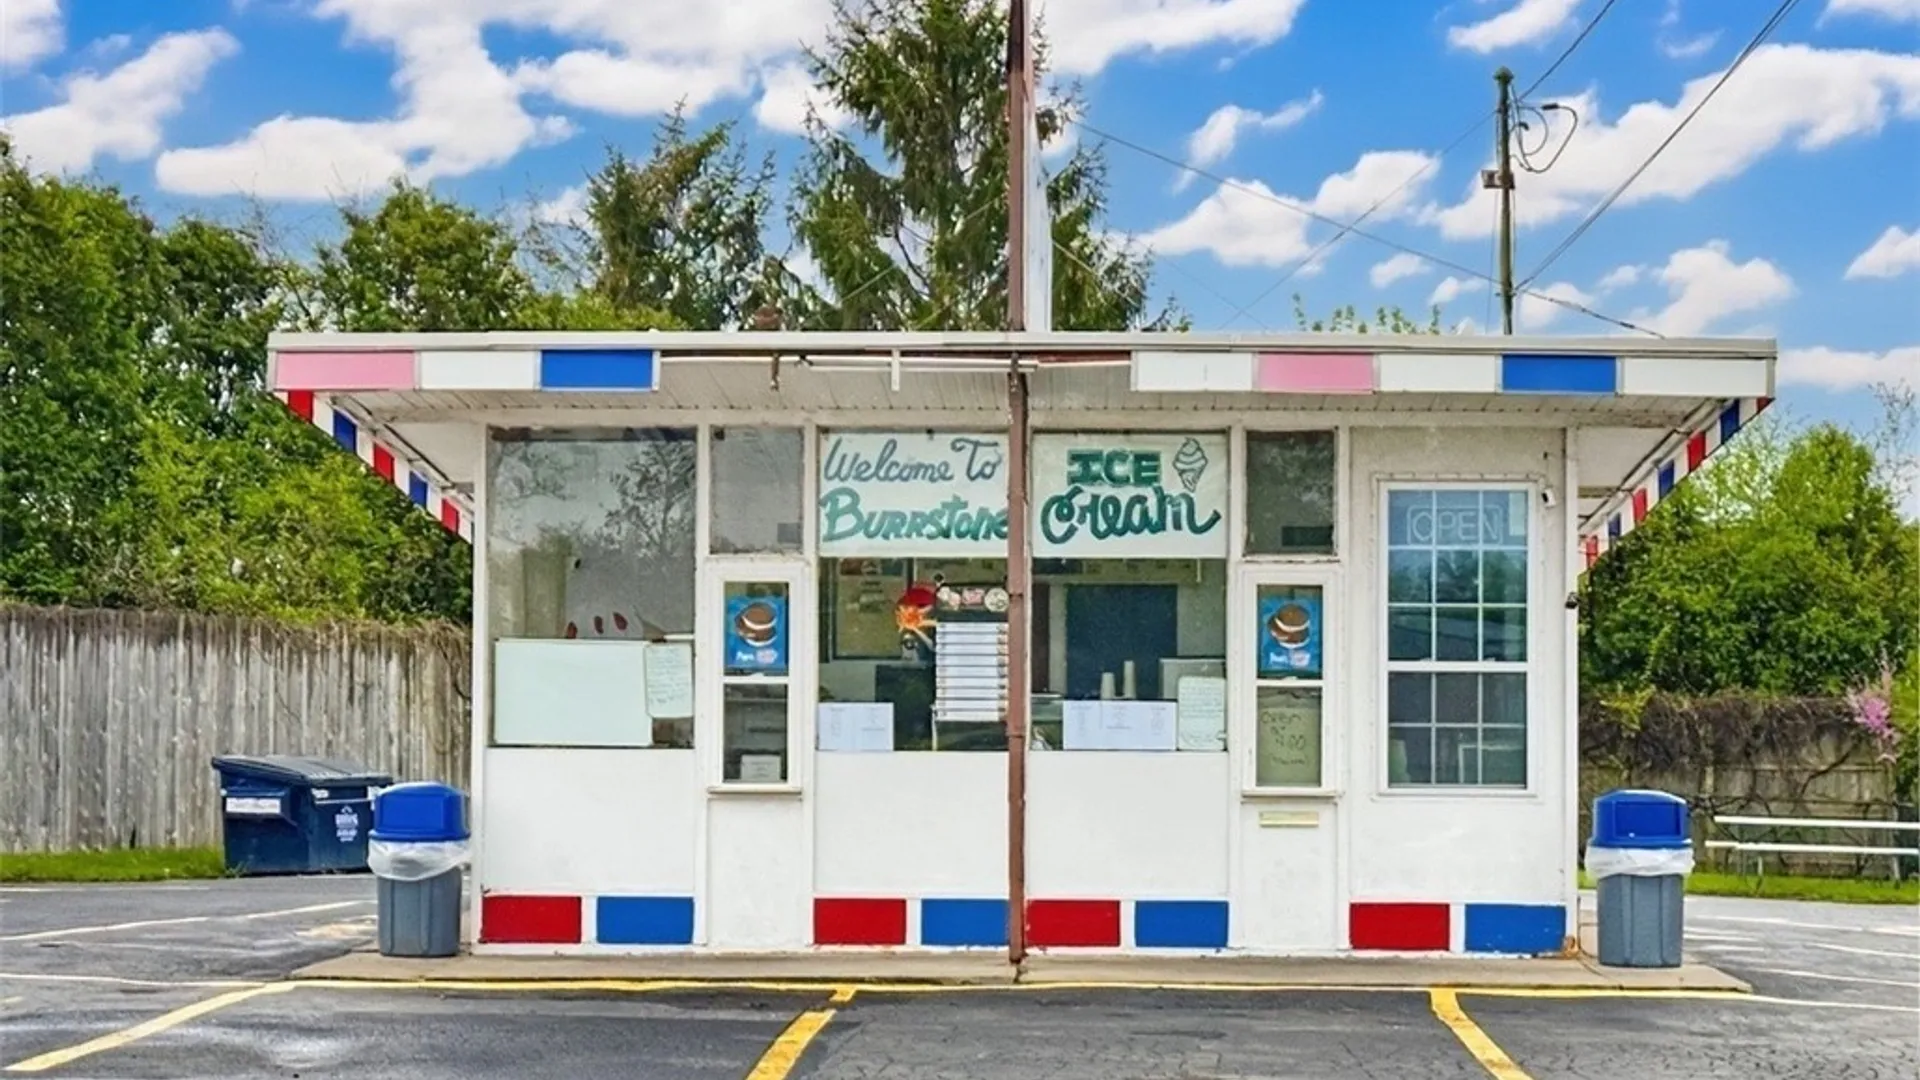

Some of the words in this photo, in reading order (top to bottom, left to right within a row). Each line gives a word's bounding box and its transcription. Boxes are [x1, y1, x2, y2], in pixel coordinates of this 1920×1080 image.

[824, 436, 954, 482] Welcome
[950, 437, 1003, 481] To
[1067, 449, 1162, 487] ICE
[1040, 485, 1222, 544] Cream
[1411, 510, 1500, 541] OPEN
